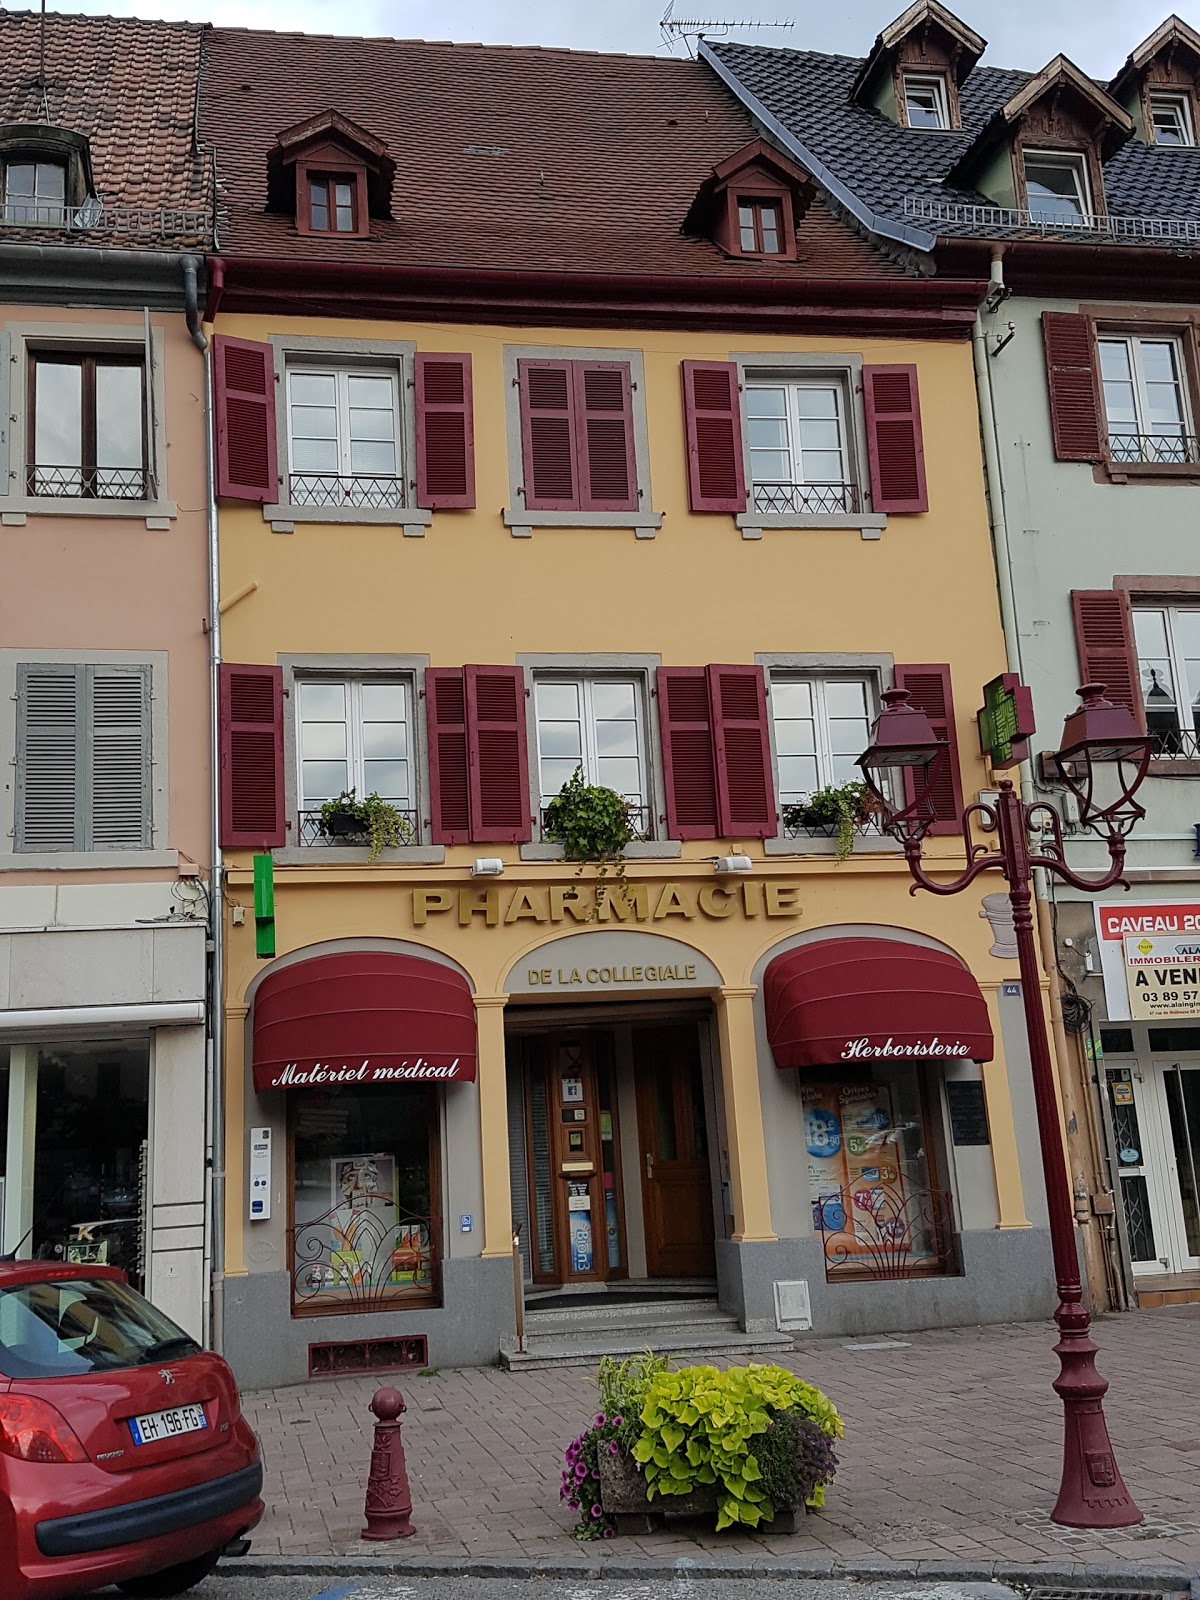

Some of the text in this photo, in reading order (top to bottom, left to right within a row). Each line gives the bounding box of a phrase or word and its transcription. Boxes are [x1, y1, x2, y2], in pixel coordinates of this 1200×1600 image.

[412, 881, 804, 926] PHARMACIE
[1107, 915, 1178, 933] CAVEAU
[528, 964, 697, 985] DE LA COLLEGIALE
[1135, 968, 1200, 987] A VEN
[1142, 990, 1199, 1002] 03 89 57
[840, 1037, 971, 1059] Herboristerie
[271, 1058, 460, 1086] Matériel médical
[576, 1229, 591, 1271] Bion3
